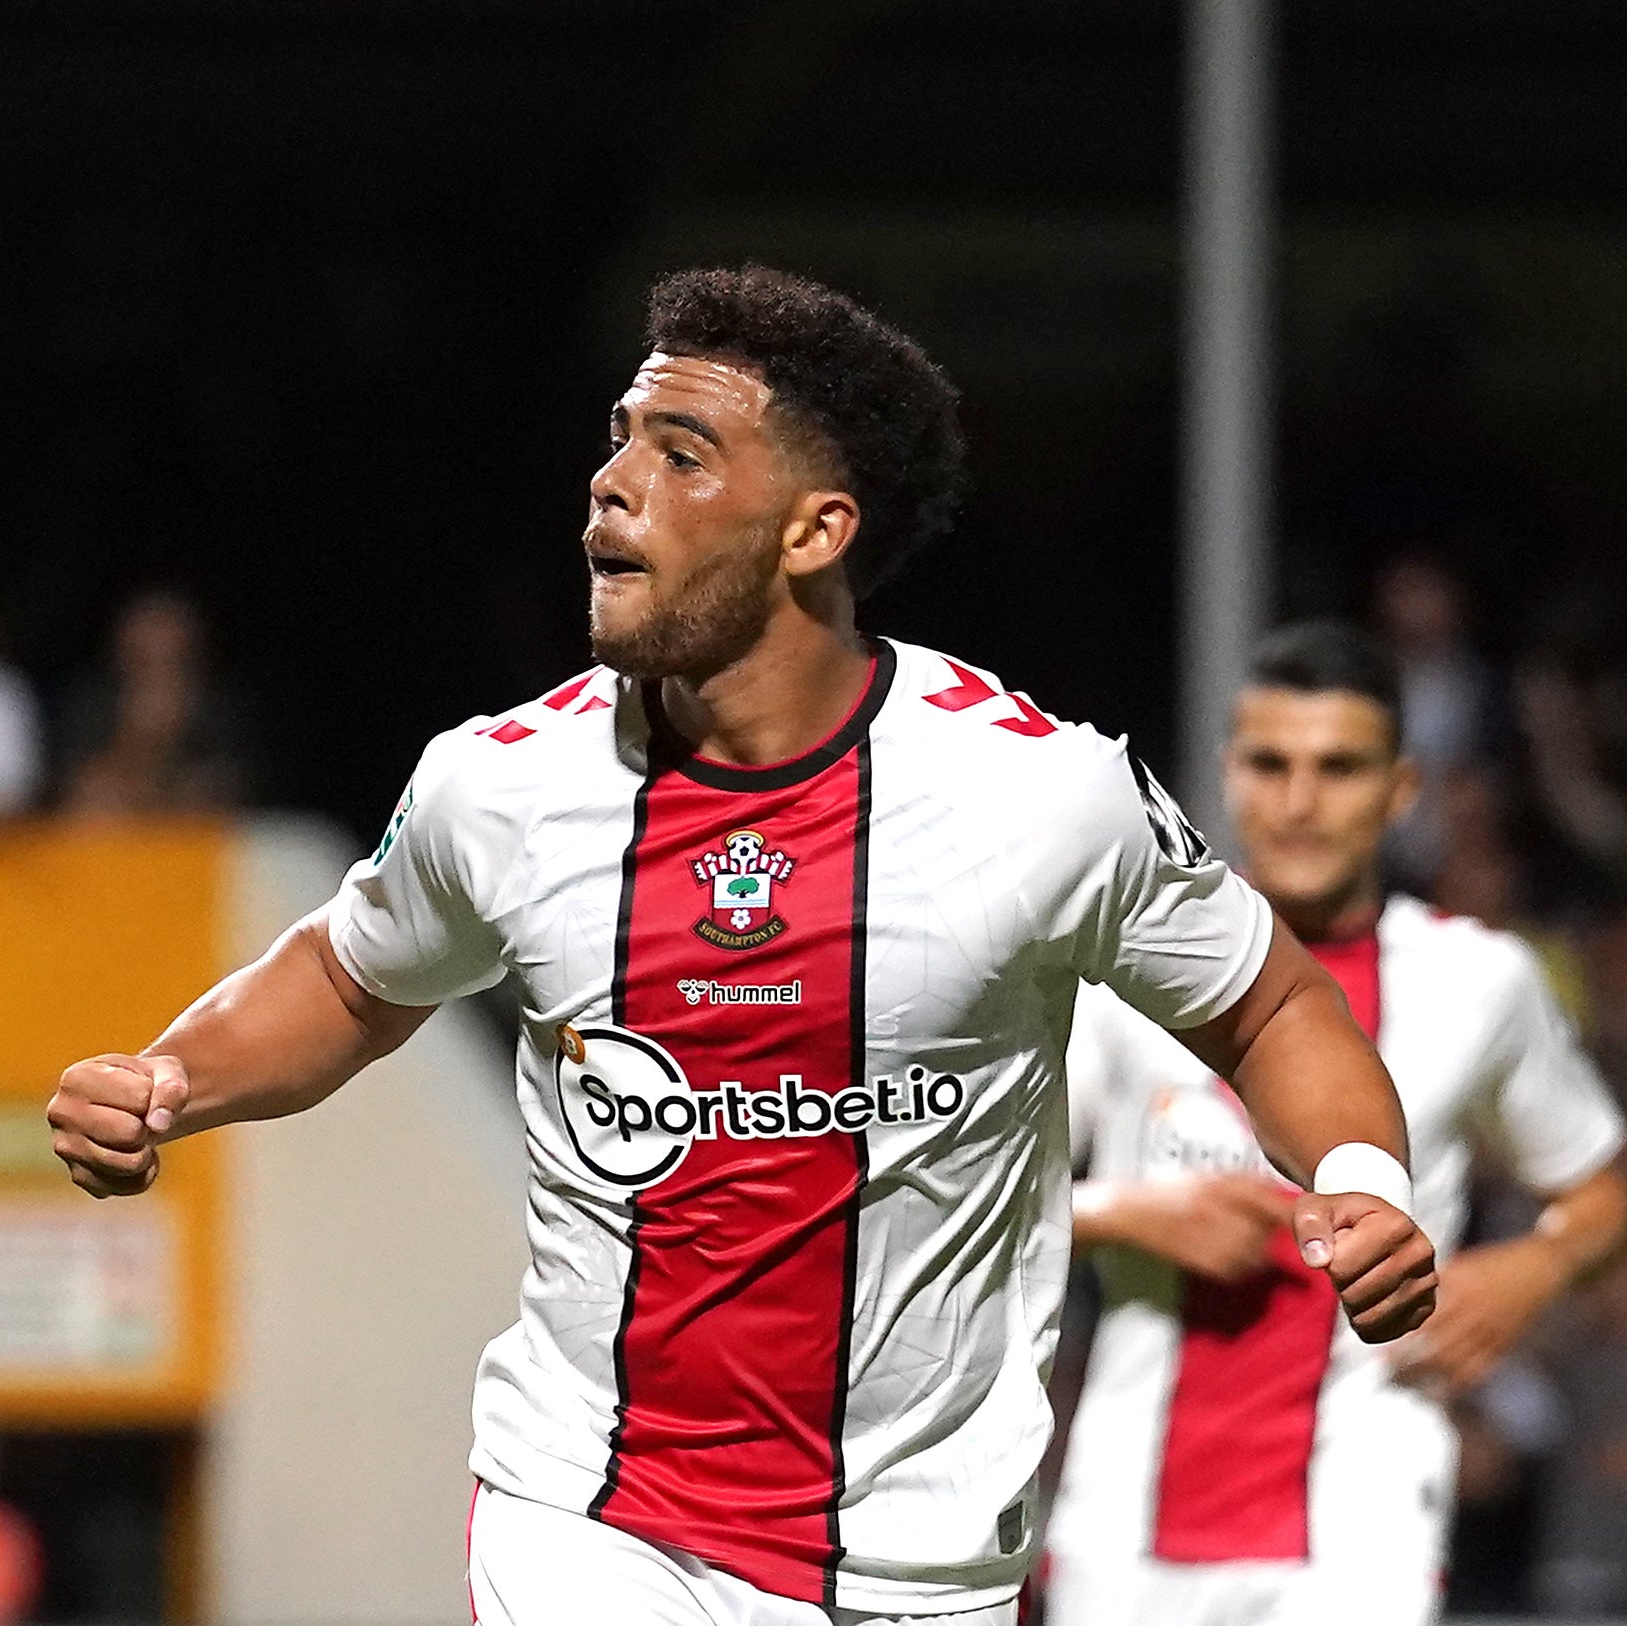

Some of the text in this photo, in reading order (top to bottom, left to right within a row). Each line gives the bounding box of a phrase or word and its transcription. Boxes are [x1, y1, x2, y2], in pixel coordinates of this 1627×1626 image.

[698, 920, 783, 947] SOUTHAMPTON FC
[710, 981, 800, 1003] hummel
[579, 1063, 966, 1143] Sportsbet.io
